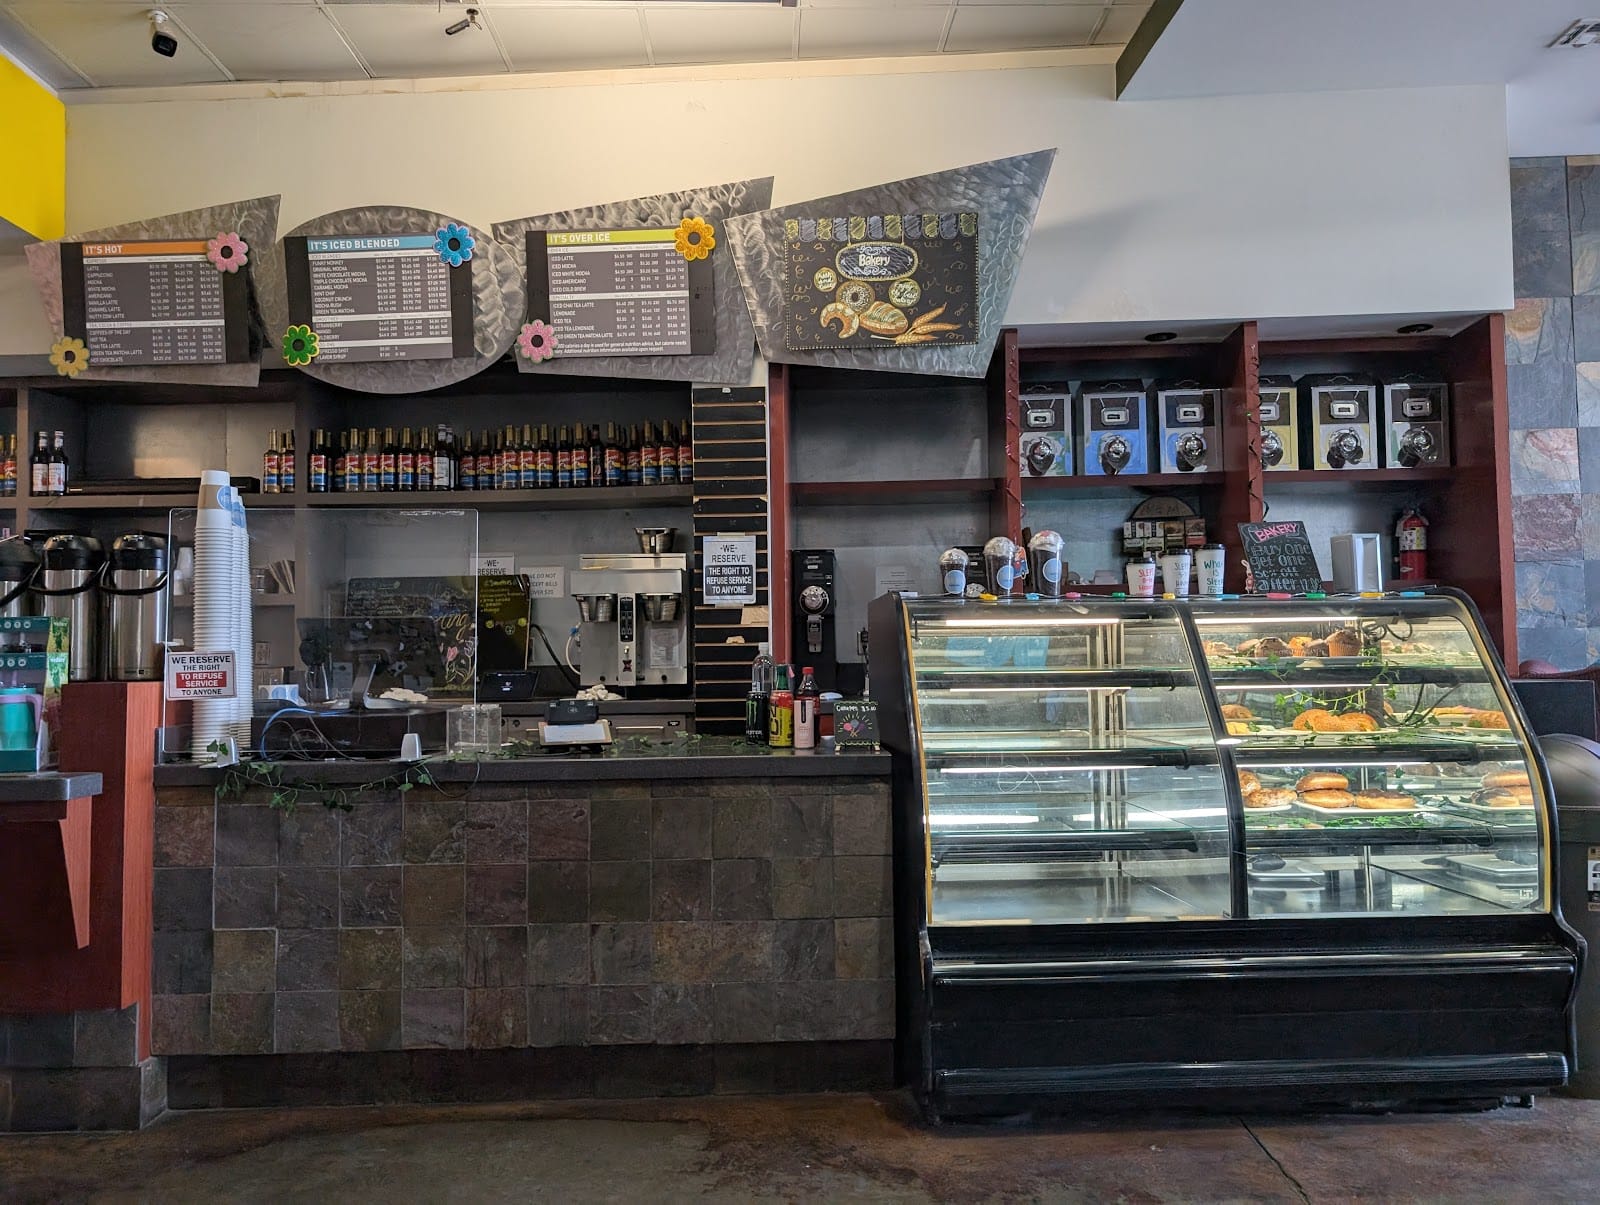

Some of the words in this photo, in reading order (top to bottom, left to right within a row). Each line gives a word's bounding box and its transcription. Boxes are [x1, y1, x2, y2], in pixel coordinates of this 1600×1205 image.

[550, 235, 566, 243] IT'S
[570, 234, 593, 242] OVER
[596, 233, 610, 242] ICE
[311, 241, 327, 250] IT'S
[330, 240, 352, 249] ICED
[355, 239, 399, 249] BLENDED
[86, 246, 102, 254] IT'S
[105, 246, 122, 254] HOT
[859, 254, 890, 266] Bakery
[1255, 523, 1297, 542] BAKERY
[709, 567, 720, 575] THE
[722, 567, 740, 575] RIGHT
